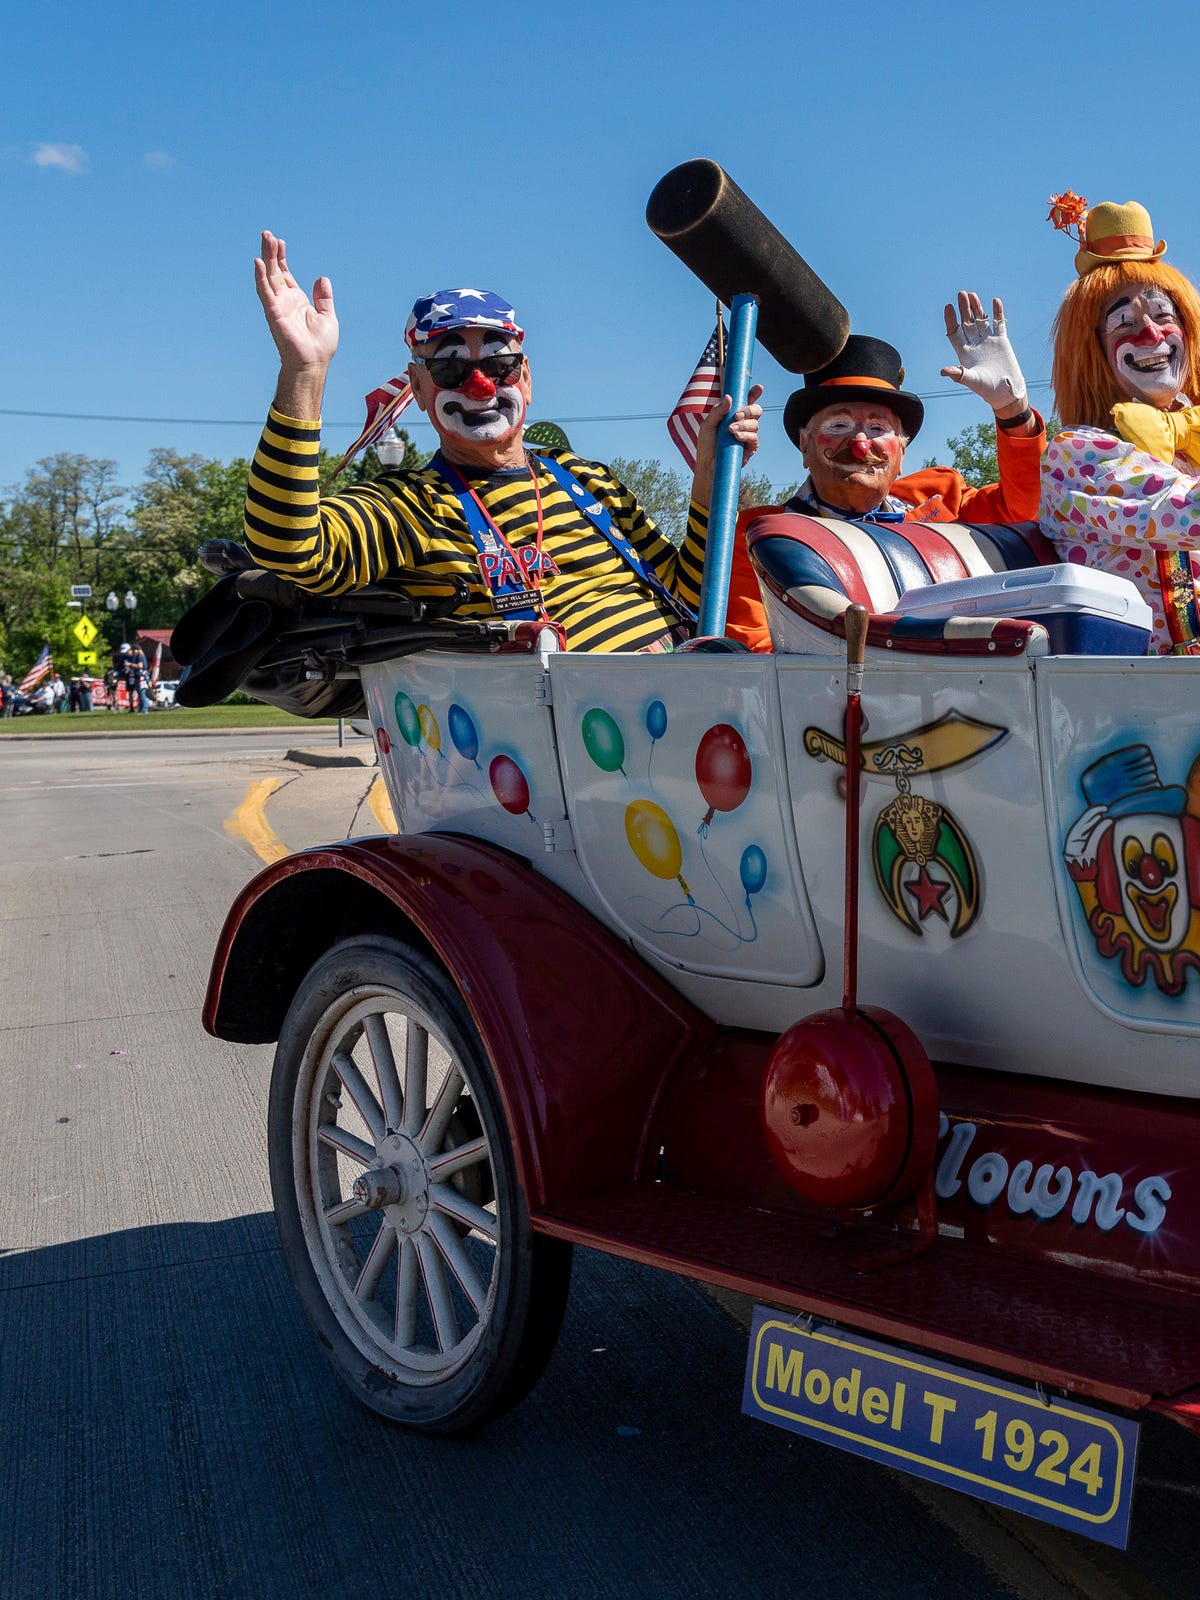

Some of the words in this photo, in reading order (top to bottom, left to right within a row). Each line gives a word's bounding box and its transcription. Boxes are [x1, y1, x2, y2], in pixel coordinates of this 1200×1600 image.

[476, 545, 561, 589] PAPA
[935, 1110, 1172, 1232] lowns
[765, 1342, 905, 1432] Model
[923, 1391, 957, 1445] T
[973, 1410, 1103, 1497] 1924
